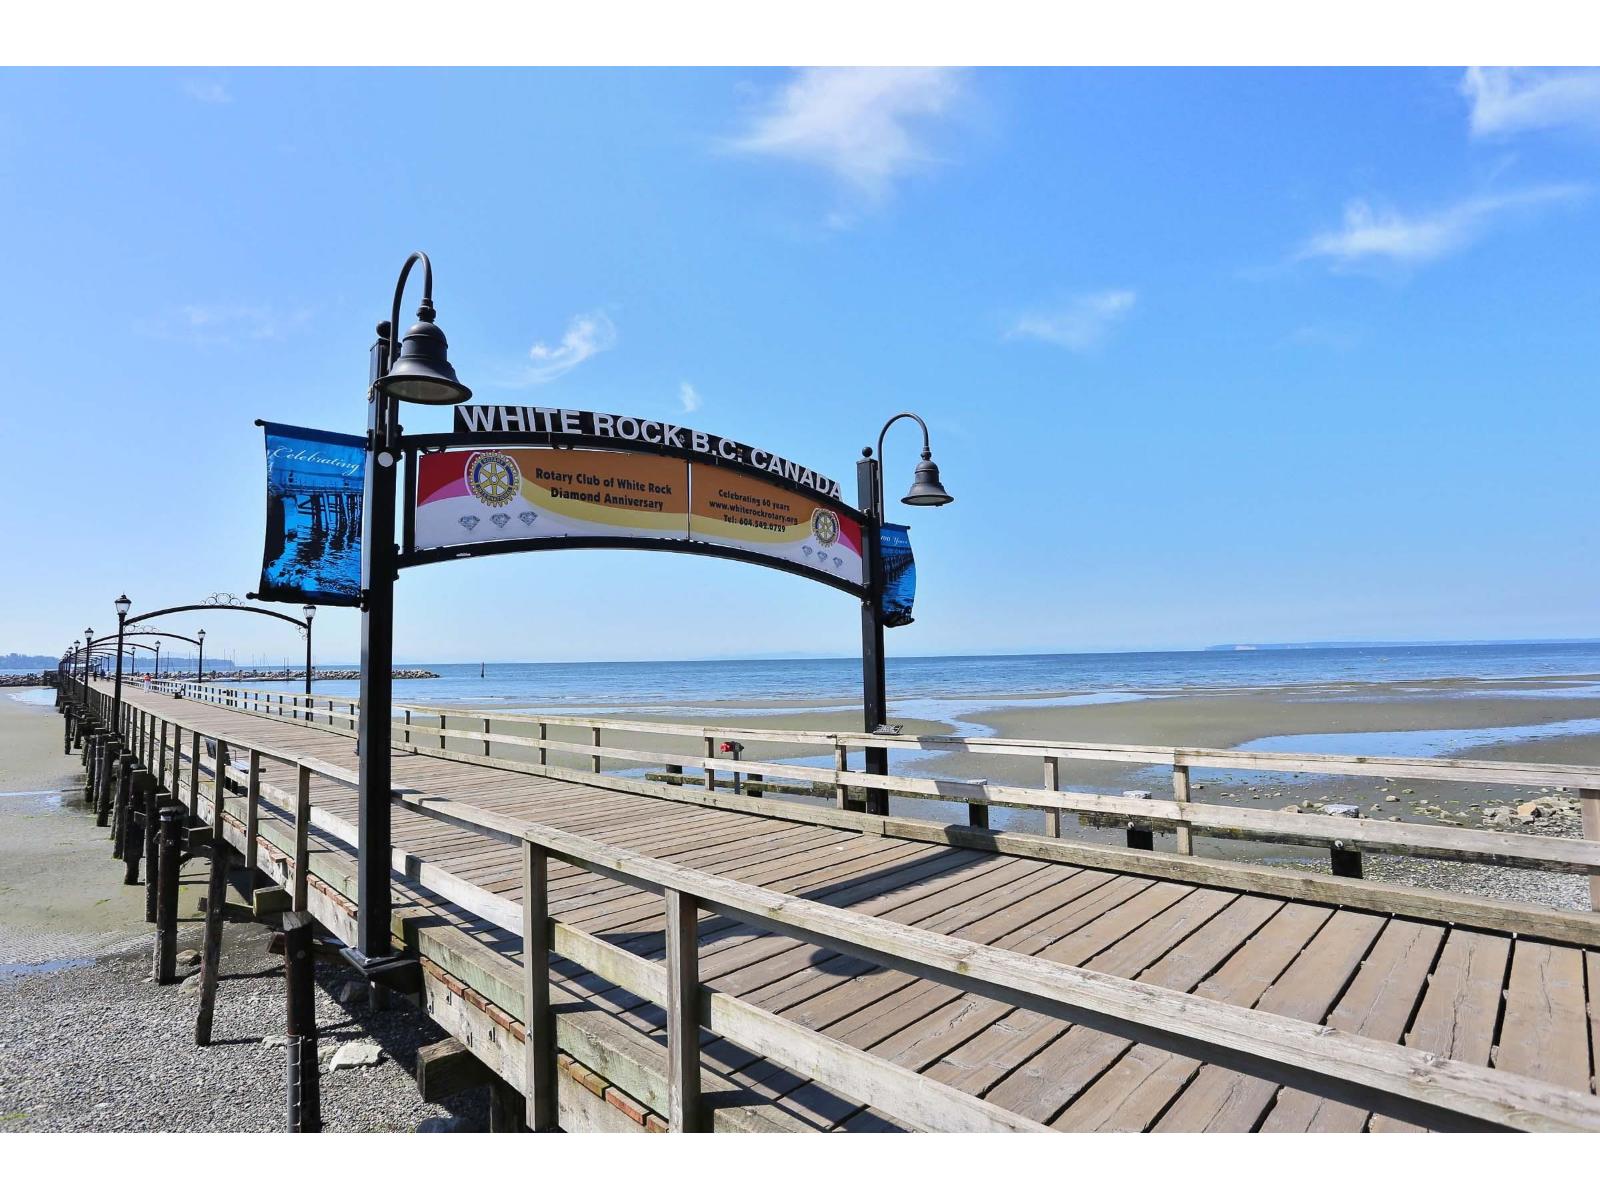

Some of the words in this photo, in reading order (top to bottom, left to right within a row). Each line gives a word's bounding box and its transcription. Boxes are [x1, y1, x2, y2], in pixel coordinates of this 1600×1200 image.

[270, 445, 361, 477] Celebrating
[458, 405, 583, 435] WHITE
[592, 412, 684, 448] ROCK
[750, 448, 843, 501] CANADA
[535, 468, 573, 485] Rotary
[576, 473, 600, 486] Club
[603, 477, 614, 488] of
[616, 479, 646, 492] White
[648, 482, 672, 495] Rock
[550, 487, 601, 503] Diamond
[603, 493, 664, 511] Anniversary
[718, 489, 761, 507] Celebrating
[762, 498, 771, 507] 60
[772, 501, 790, 511] years
[709, 501, 798, 525] www.whiterockrotary.org
[723, 514, 737, 524] Tel:
